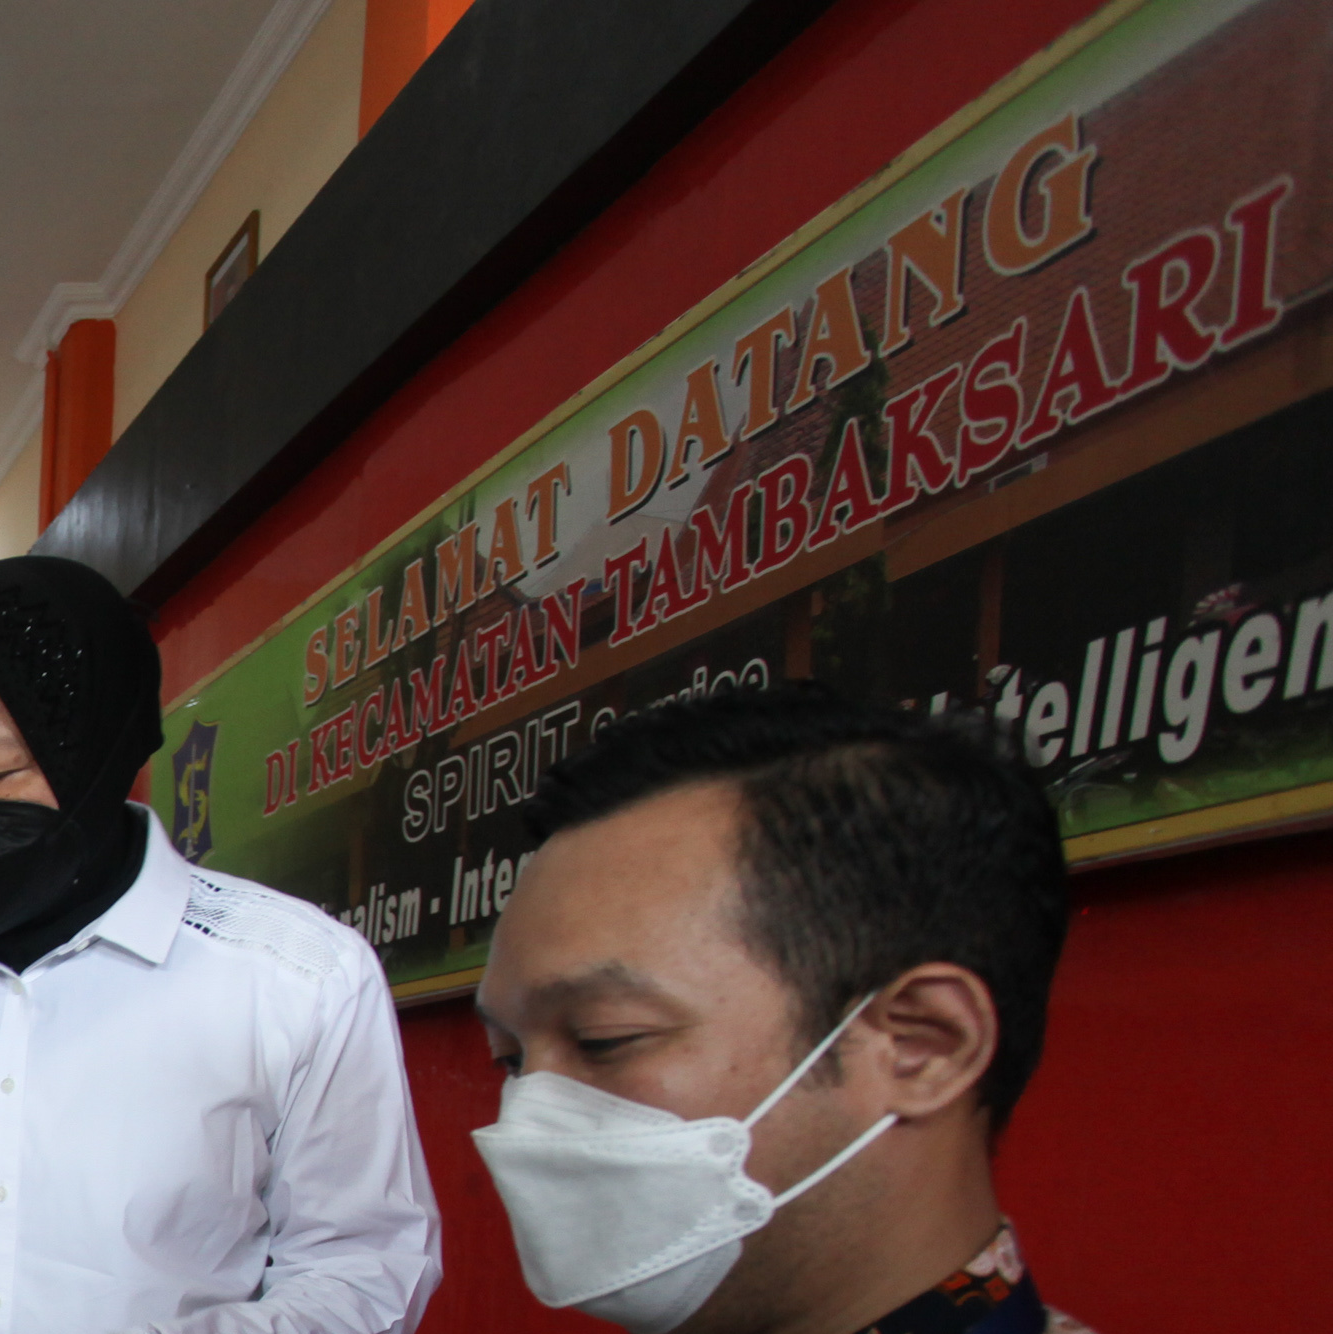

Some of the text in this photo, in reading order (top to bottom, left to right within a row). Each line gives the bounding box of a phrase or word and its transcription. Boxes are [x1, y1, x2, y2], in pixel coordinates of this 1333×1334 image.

[262, 174, 1295, 818] DI KECAMATAN TAMBAKSARI
[302, 110, 1097, 708] SELAMAT DATANG
[402, 700, 582, 842] SPIRIT
